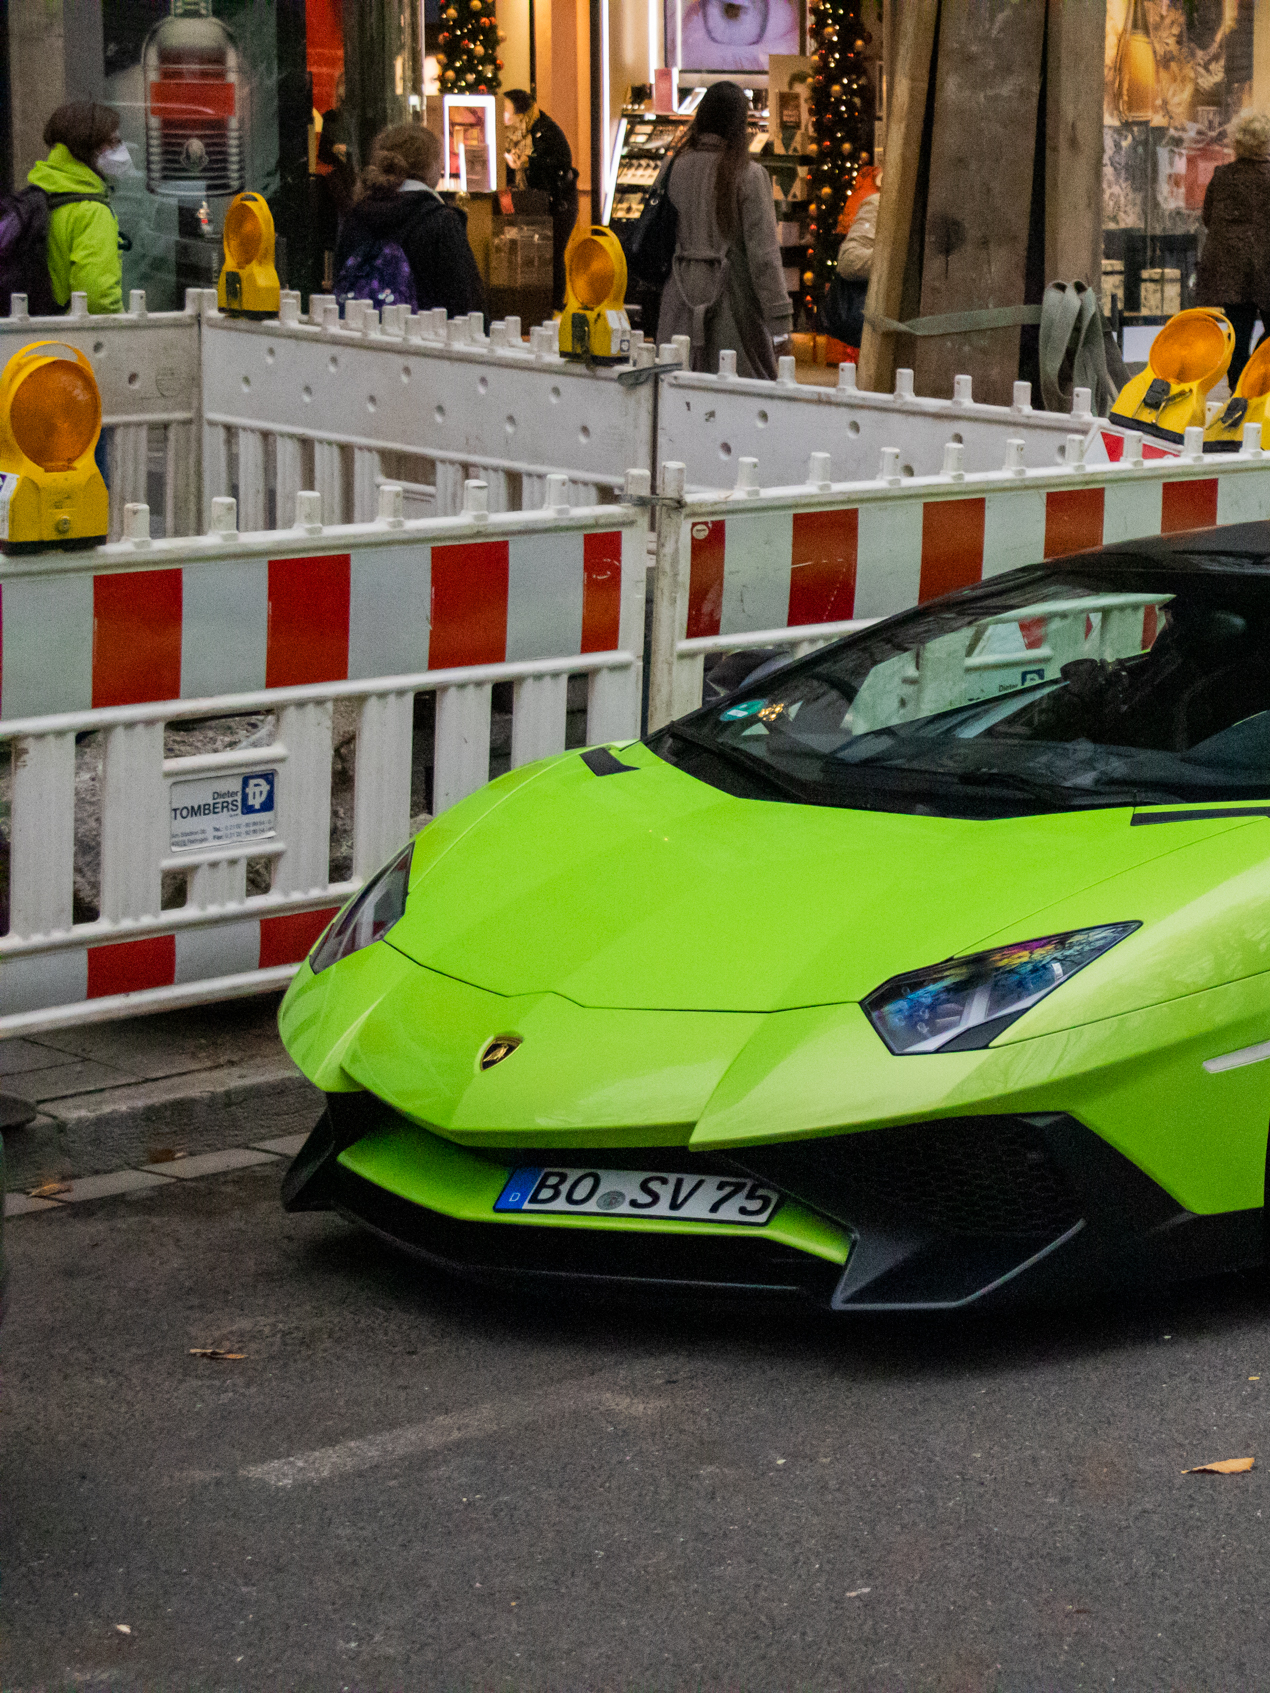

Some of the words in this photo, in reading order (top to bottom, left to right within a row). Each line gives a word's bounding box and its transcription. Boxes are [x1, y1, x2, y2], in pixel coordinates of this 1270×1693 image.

[212, 790, 240, 801] Dieter
[171, 799, 239, 820] TOMBERS
[509, 1192, 521, 1202] D
[527, 1171, 601, 1206] BO
[629, 1176, 705, 1211] SV
[708, 1180, 773, 1217] 75
